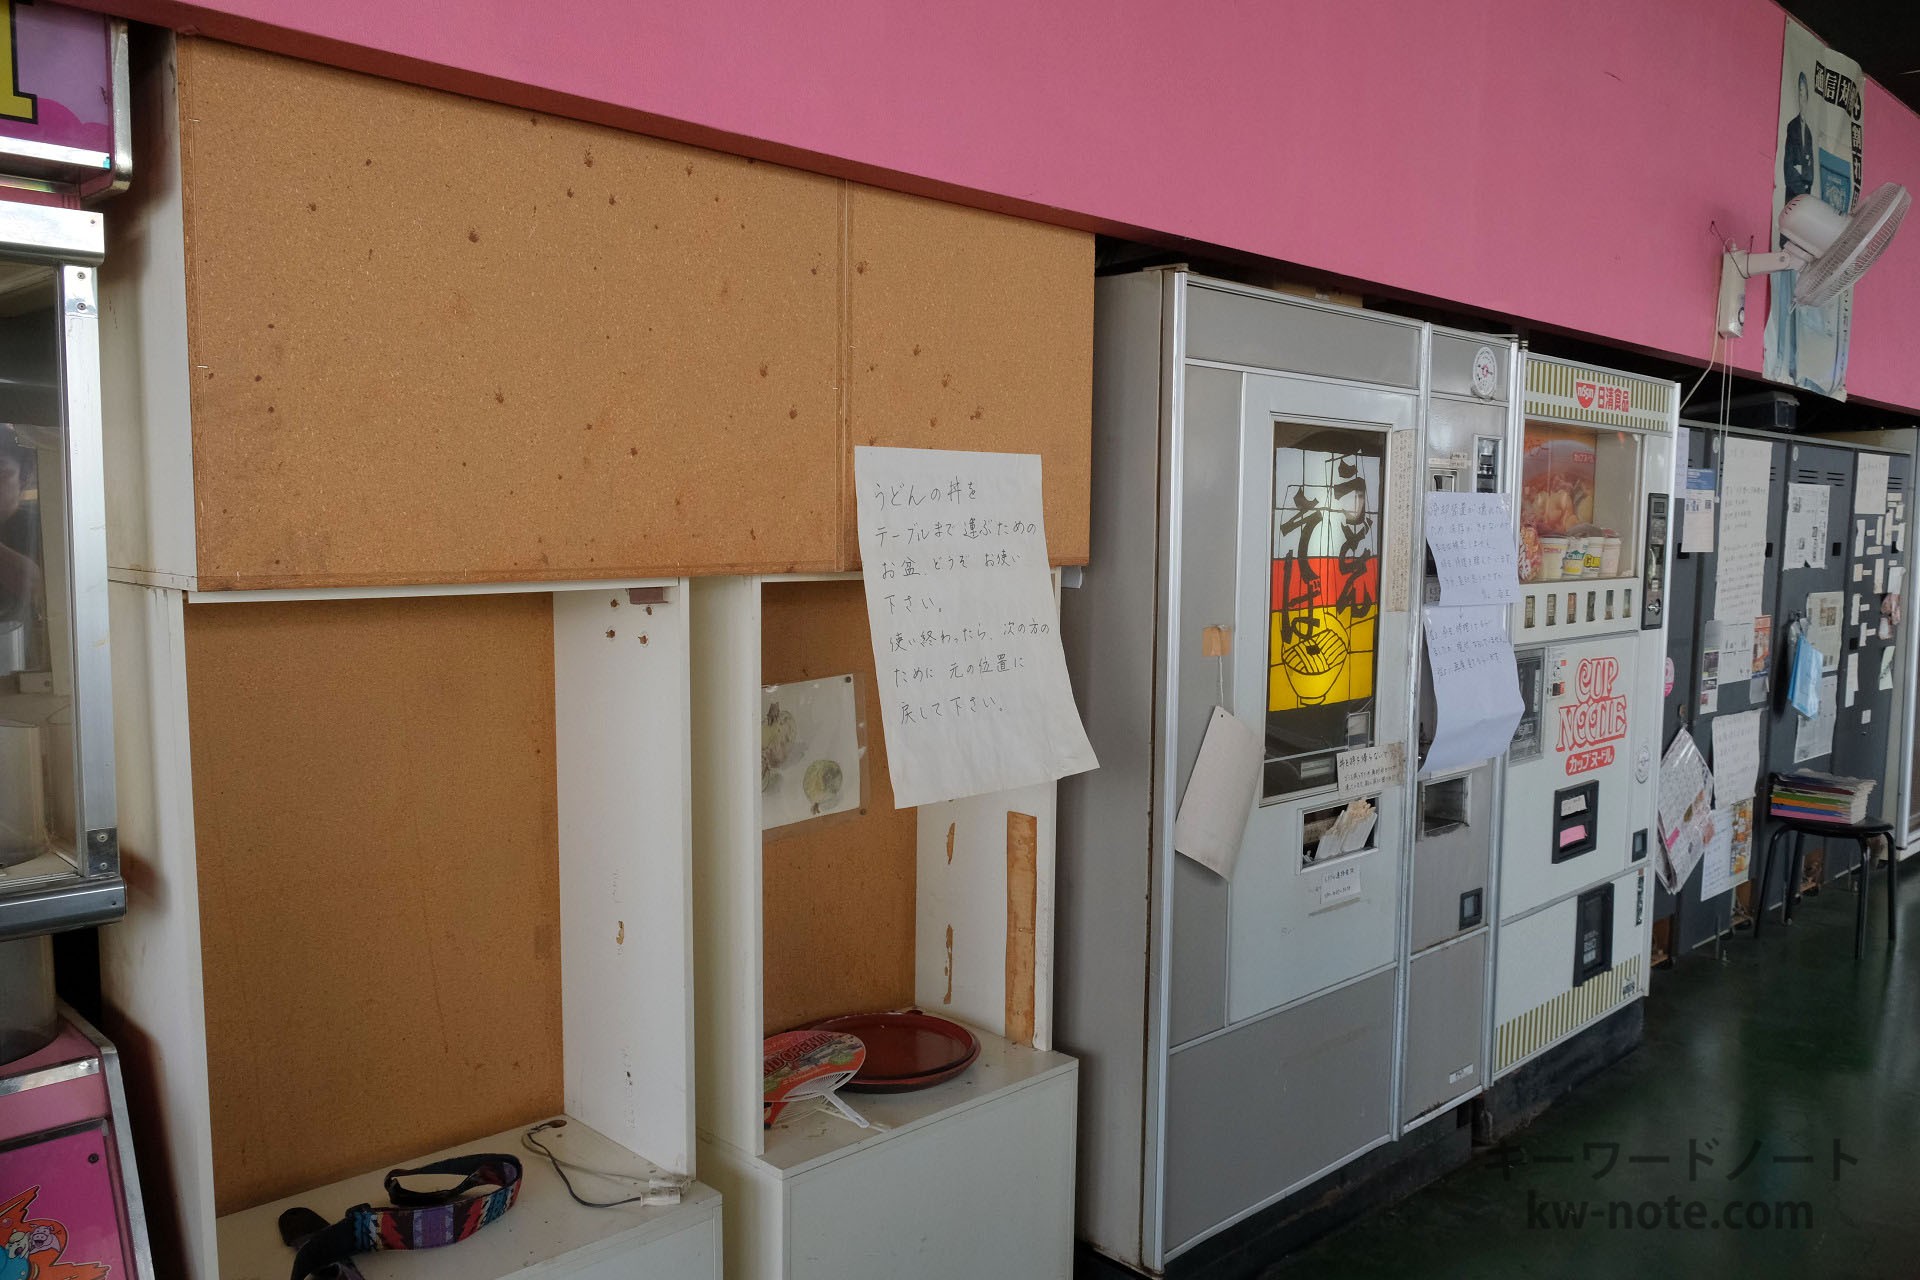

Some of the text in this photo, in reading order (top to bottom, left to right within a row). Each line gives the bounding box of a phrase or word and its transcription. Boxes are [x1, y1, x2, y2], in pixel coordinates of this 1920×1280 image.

[1598, 386, 1629, 412] 日清食品
[874, 475, 977, 508] うどんの丼を
[1575, 656, 1619, 702] CUP
[1568, 750, 1613, 774] カップヌードル
